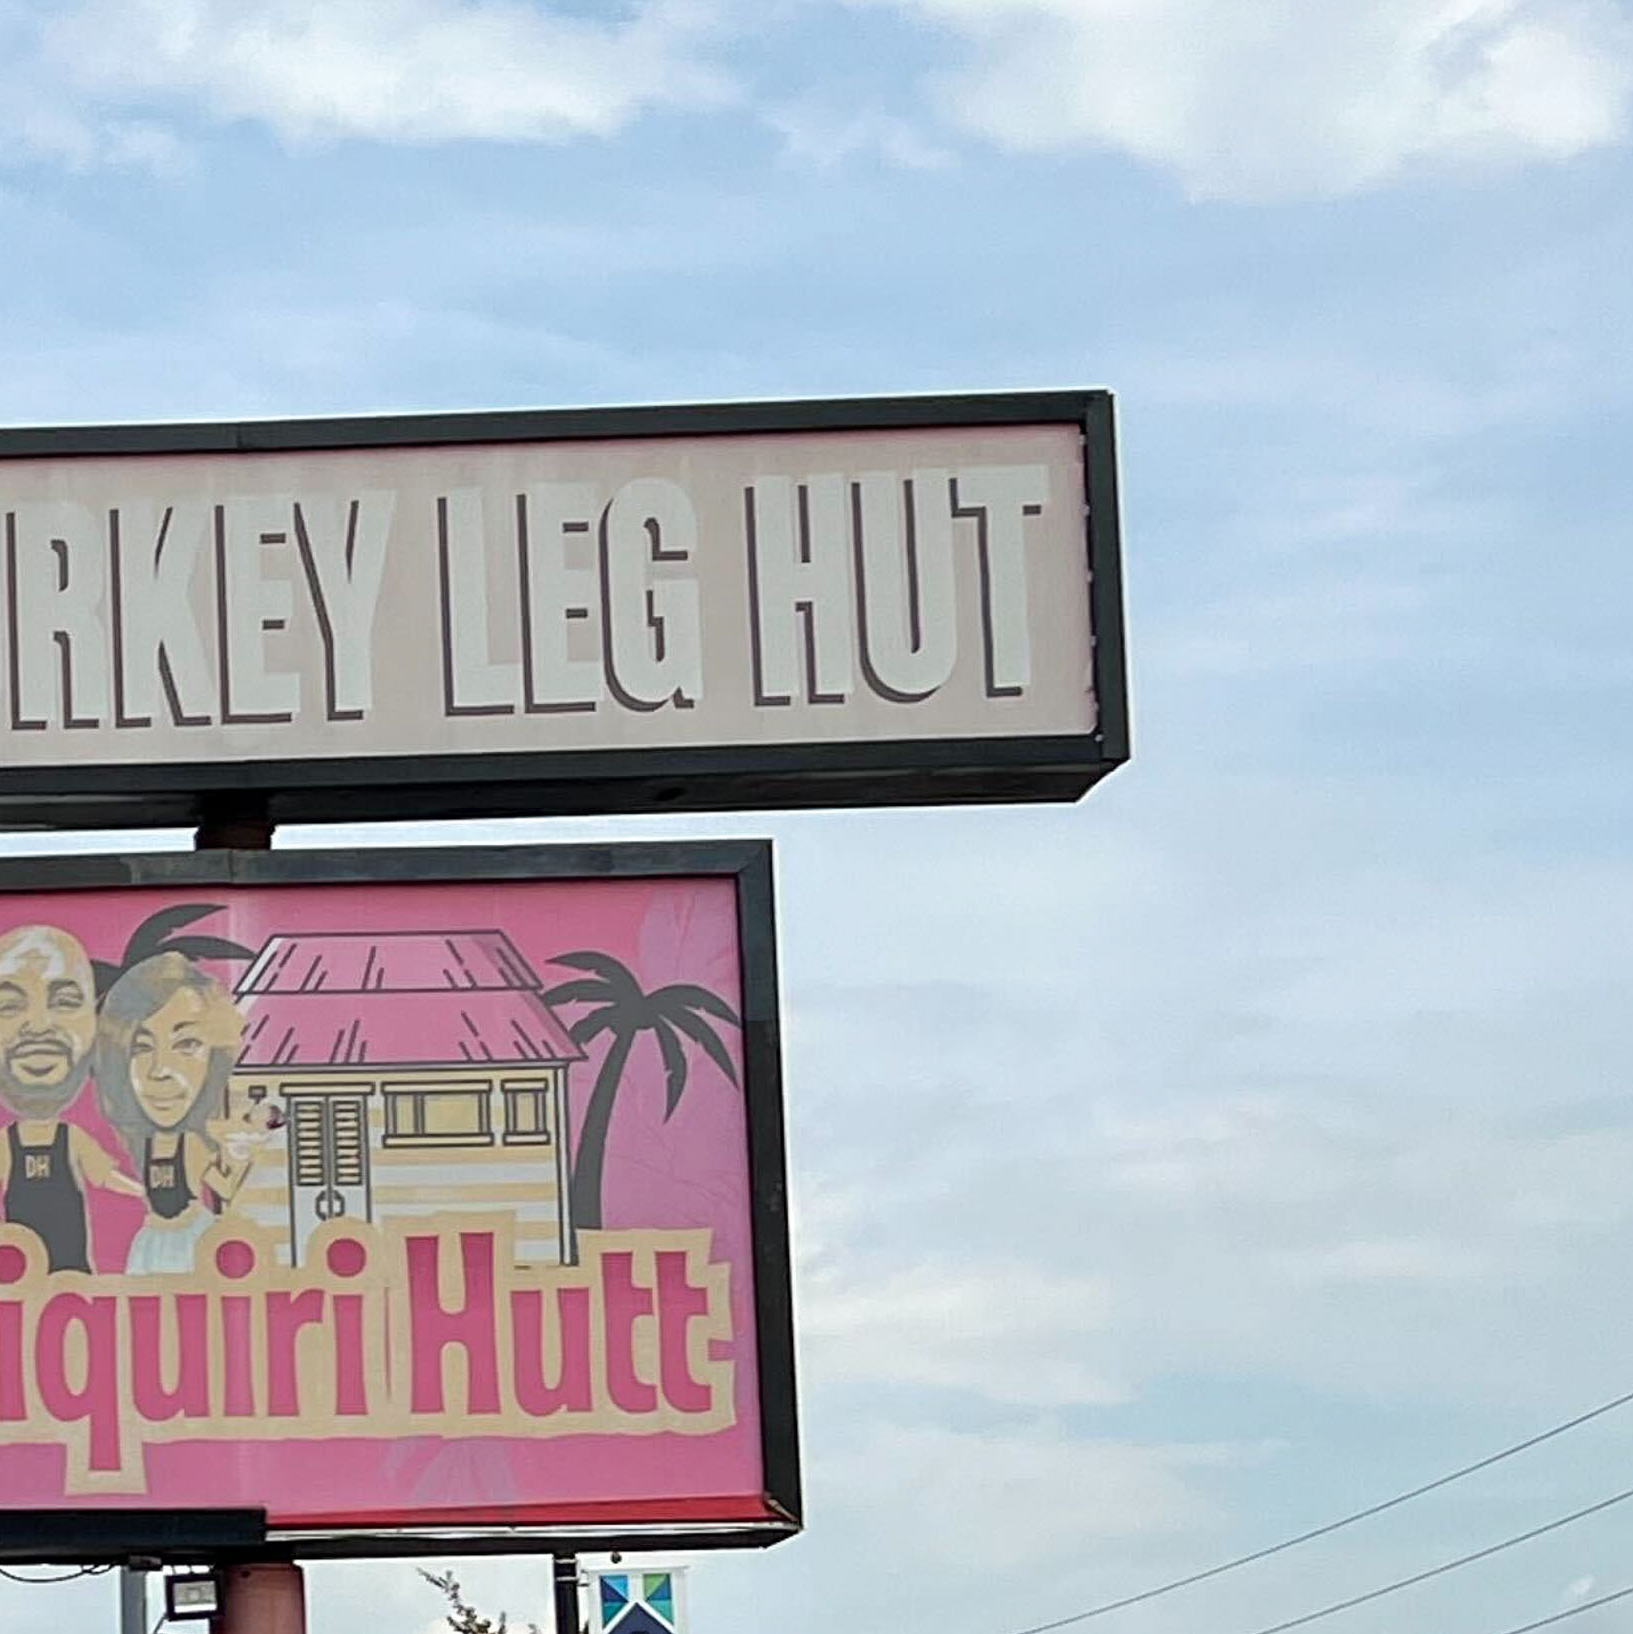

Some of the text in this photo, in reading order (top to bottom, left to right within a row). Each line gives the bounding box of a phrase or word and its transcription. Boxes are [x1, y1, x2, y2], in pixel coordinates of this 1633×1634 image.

[437, 477, 703, 717] LEG
[745, 465, 1049, 706] HUT
[25, 1154, 51, 1180] DH
[149, 1164, 175, 1189] DH
[404, 1231, 713, 1416] Hutt
